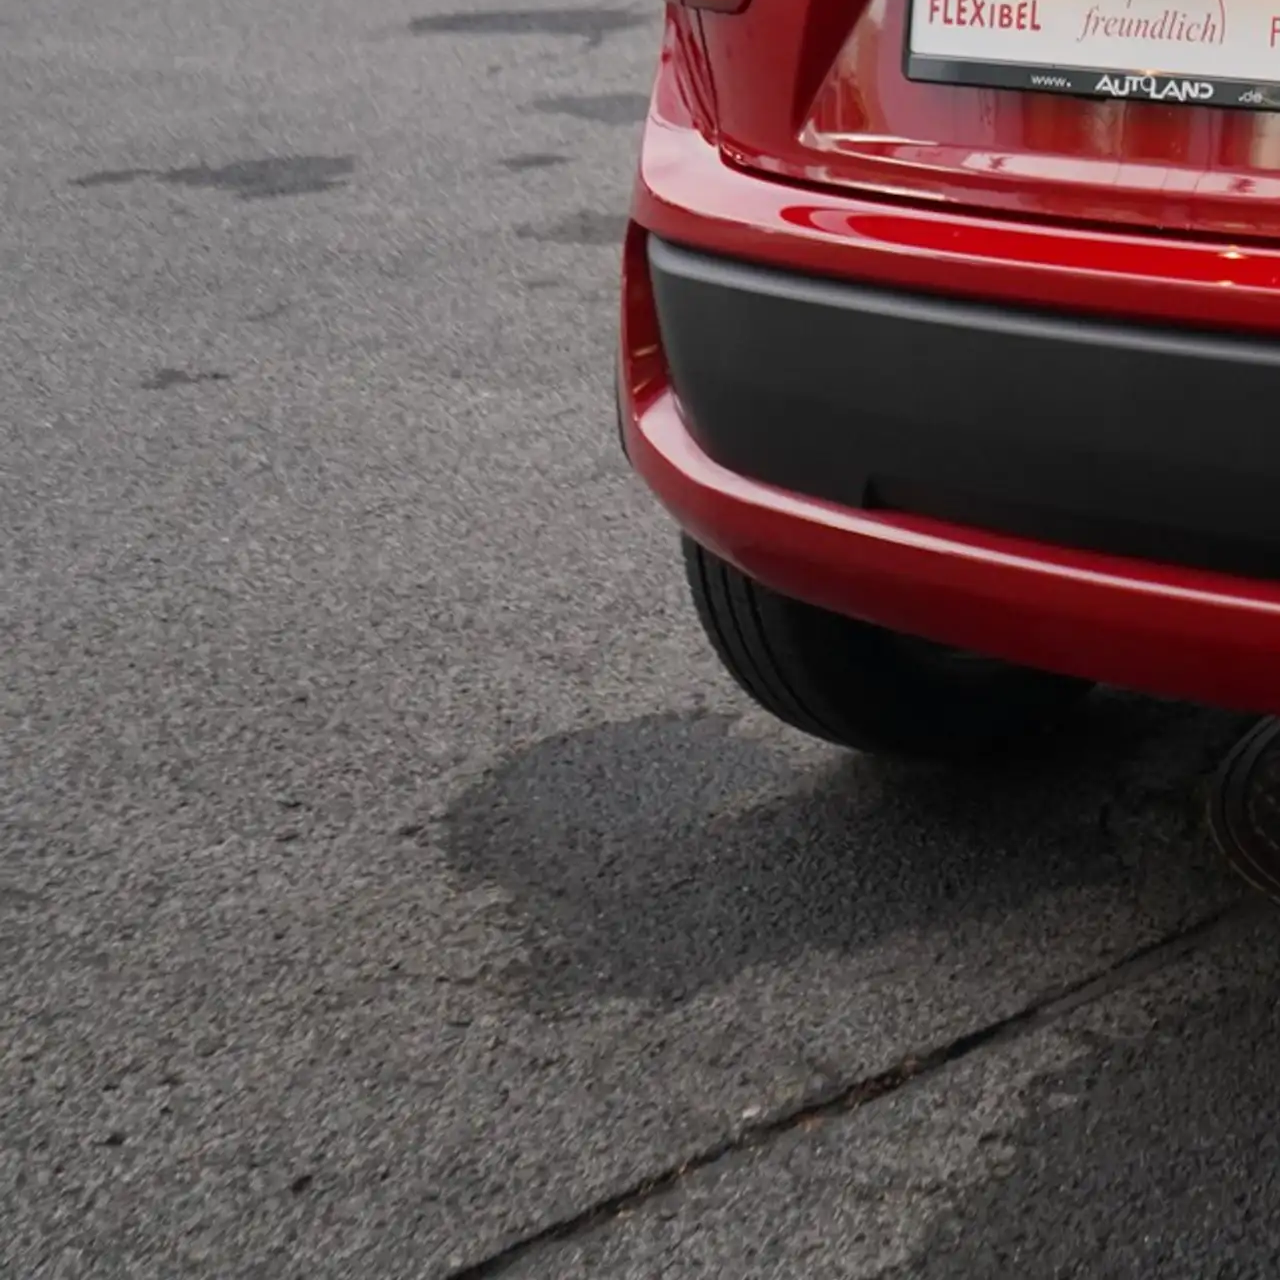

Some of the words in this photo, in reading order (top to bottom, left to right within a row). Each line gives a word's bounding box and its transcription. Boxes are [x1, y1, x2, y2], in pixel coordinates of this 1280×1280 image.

[1076, 4, 1218, 44] freundlich
[1031, 74, 1071, 88] www.
[1095, 73, 1214, 102] AUTOLAND
[1238, 89, 1263, 104] .de
